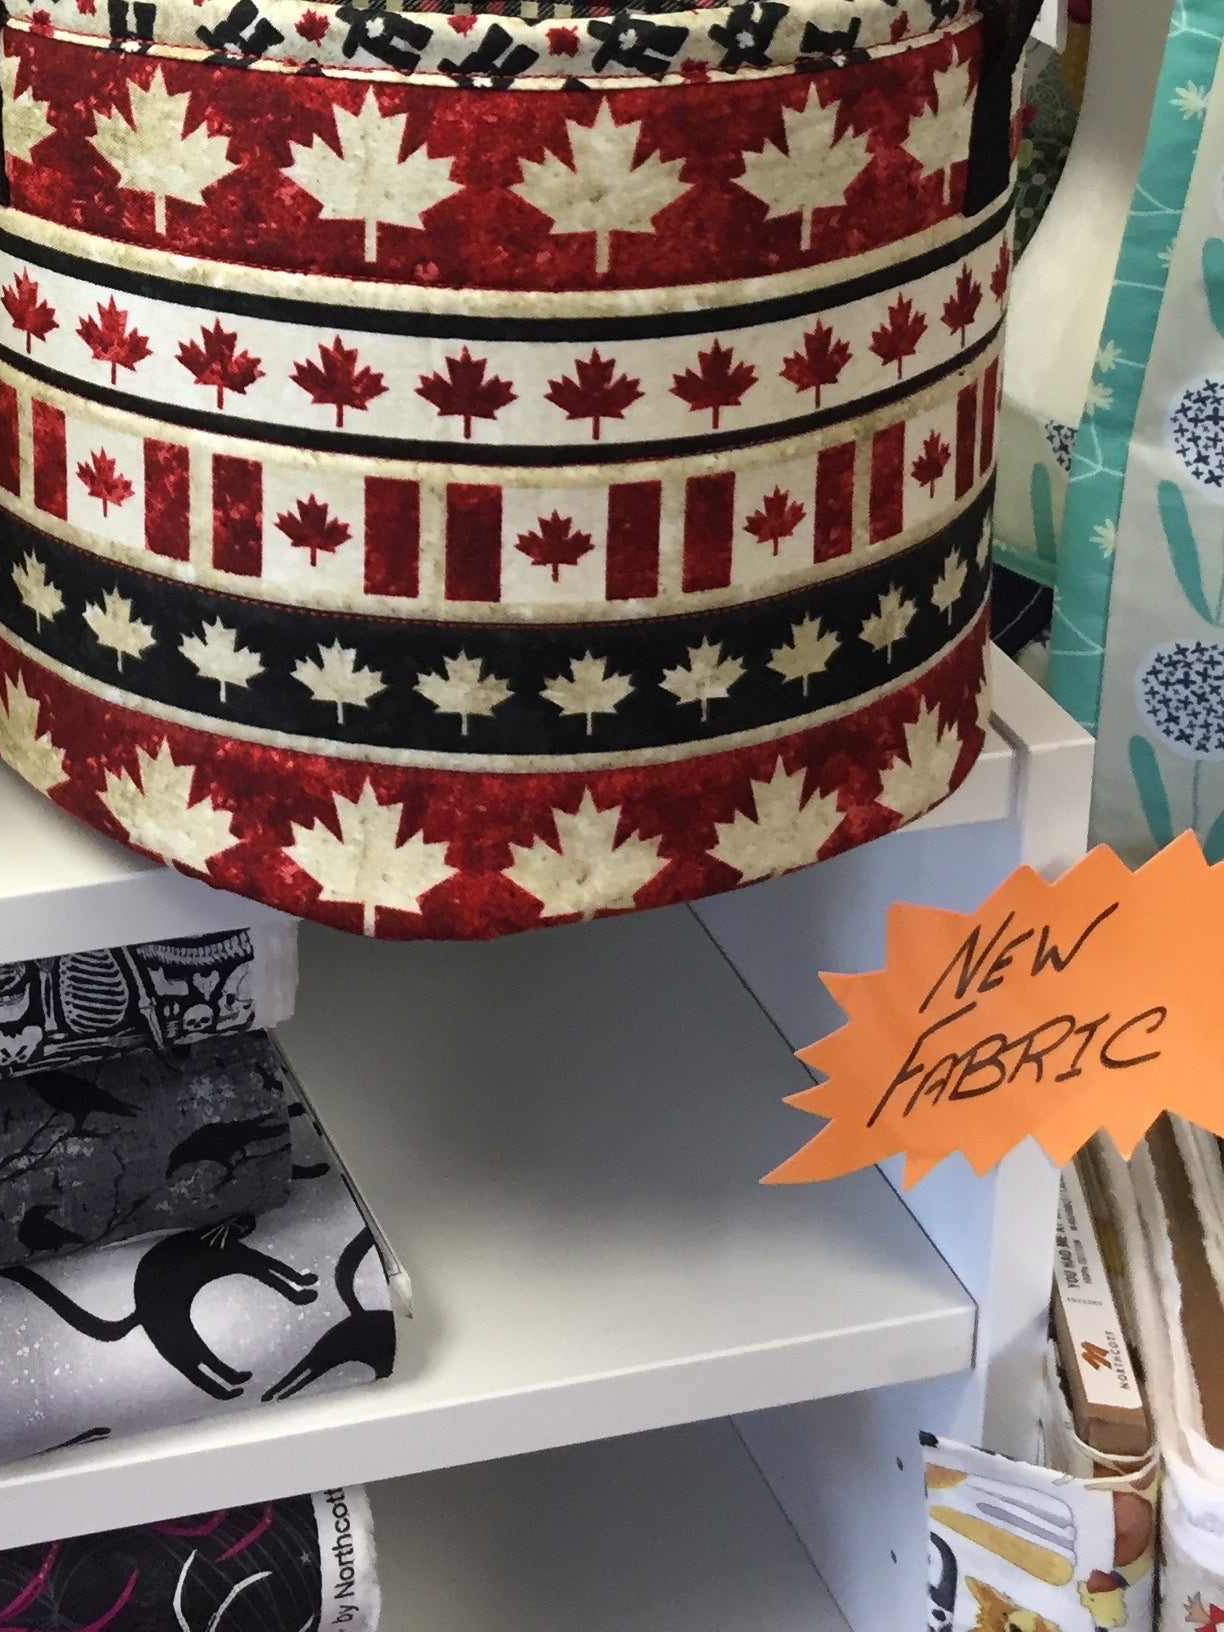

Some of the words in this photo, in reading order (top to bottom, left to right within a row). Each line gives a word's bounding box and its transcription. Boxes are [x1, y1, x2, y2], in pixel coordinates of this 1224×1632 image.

[918, 901, 1119, 1014] NEW
[866, 1001, 1167, 1128] FABRIC
[1104, 1330, 1131, 1390] NORTHCOTT
[324, 1486, 356, 1599] Northcott
[331, 1604, 359, 1624] by
